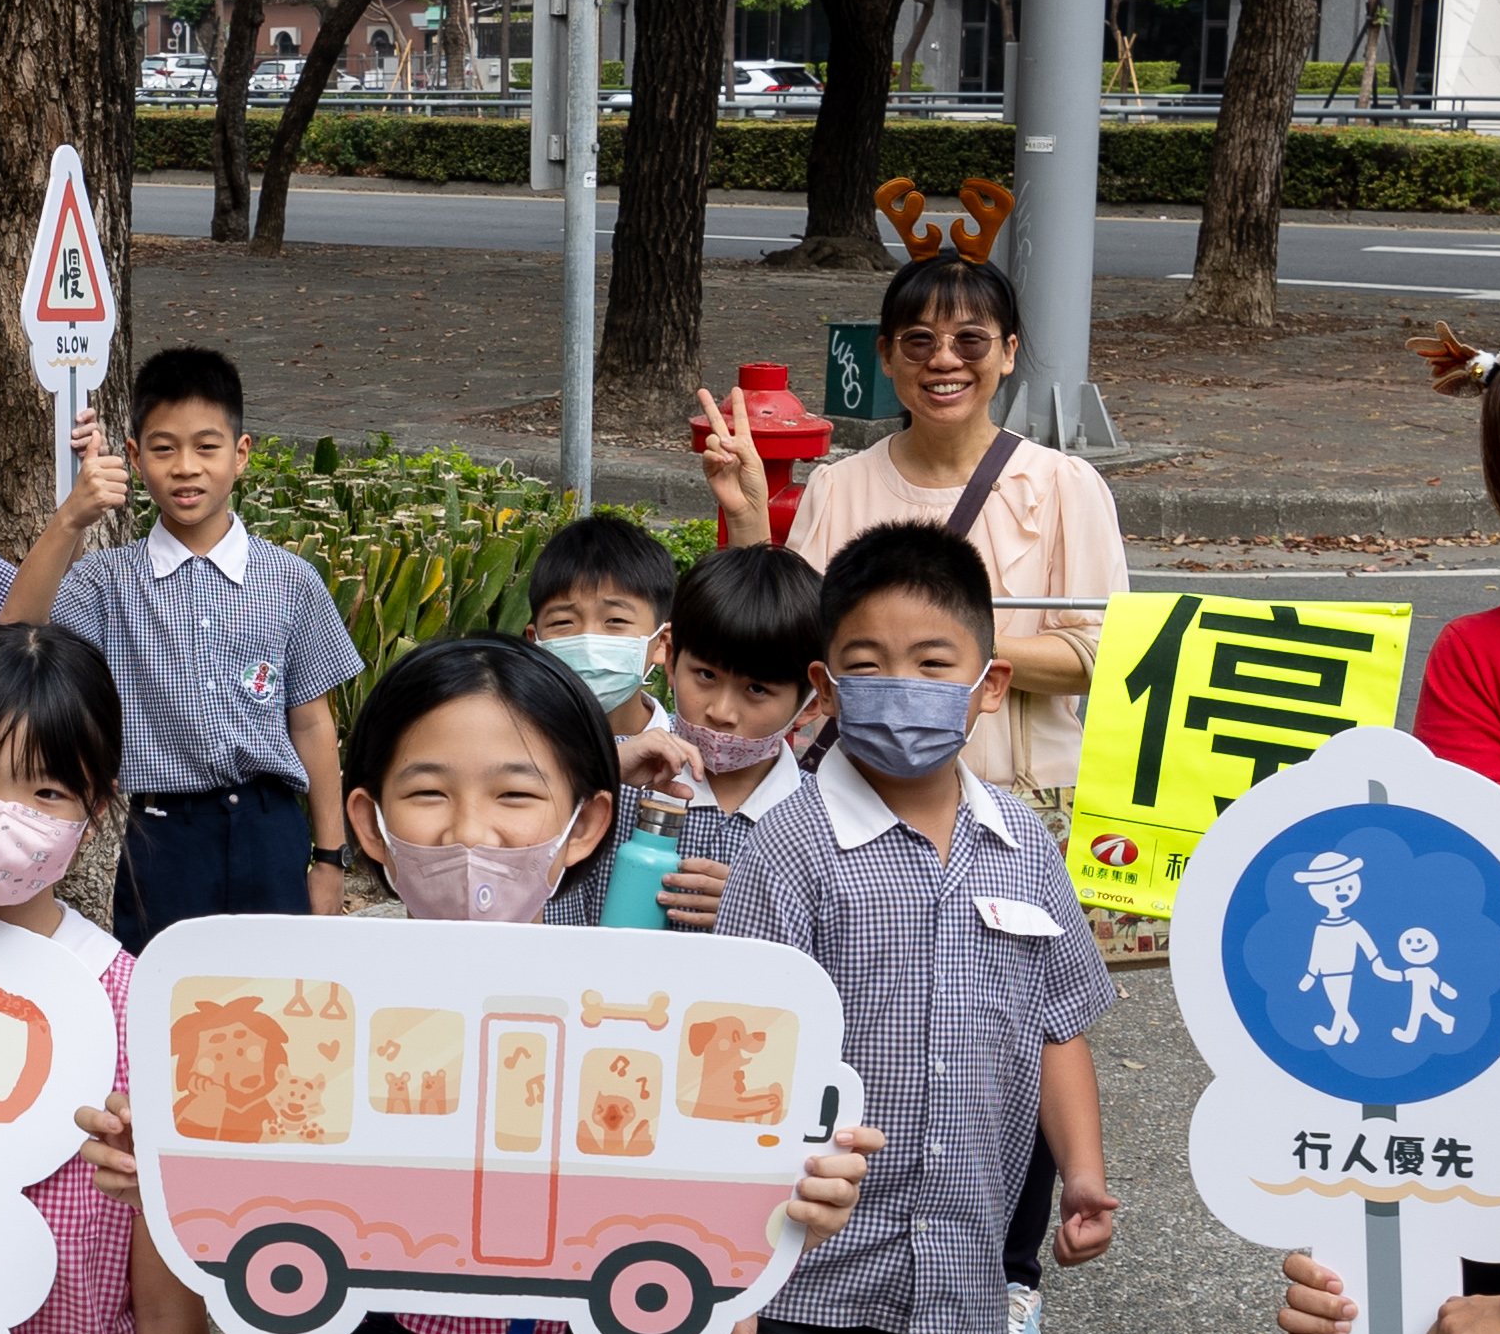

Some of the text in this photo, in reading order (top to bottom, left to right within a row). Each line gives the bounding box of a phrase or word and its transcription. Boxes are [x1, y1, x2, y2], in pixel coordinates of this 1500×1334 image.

[59, 247, 85, 299] 慢
[56, 335, 89, 354] SLOW
[1124, 594, 1375, 816] 停
[1081, 864, 1138, 885] 和泰集團
[1097, 891, 1134, 905] TOYOTA
[1292, 1130, 1474, 1178] 行人優先
